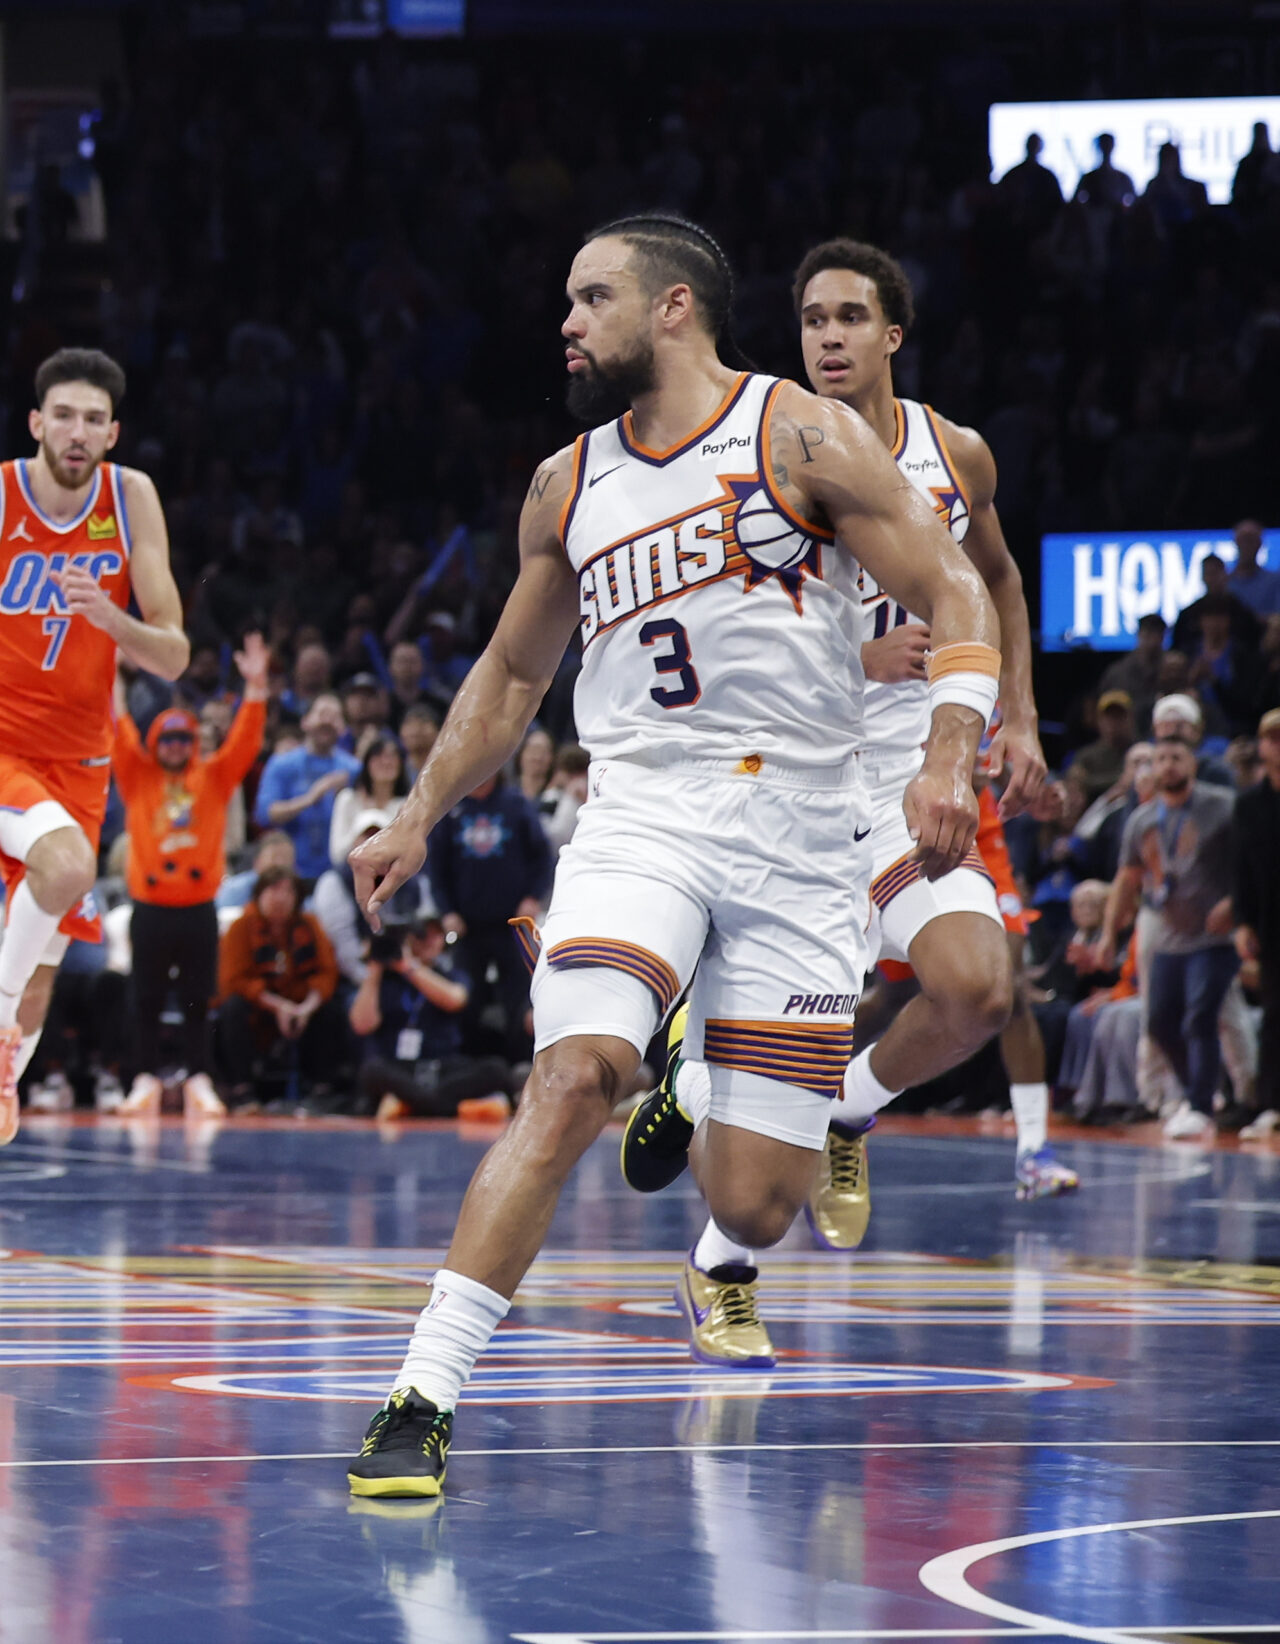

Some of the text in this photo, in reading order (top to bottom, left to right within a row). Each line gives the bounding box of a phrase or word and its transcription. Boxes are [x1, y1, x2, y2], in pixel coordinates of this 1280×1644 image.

[701, 435, 752, 456] PayPal
[905, 458, 940, 473] PayPal
[1072, 541, 1239, 637] HOM
[40, 615, 72, 672] 7
[639, 617, 703, 711] 3
